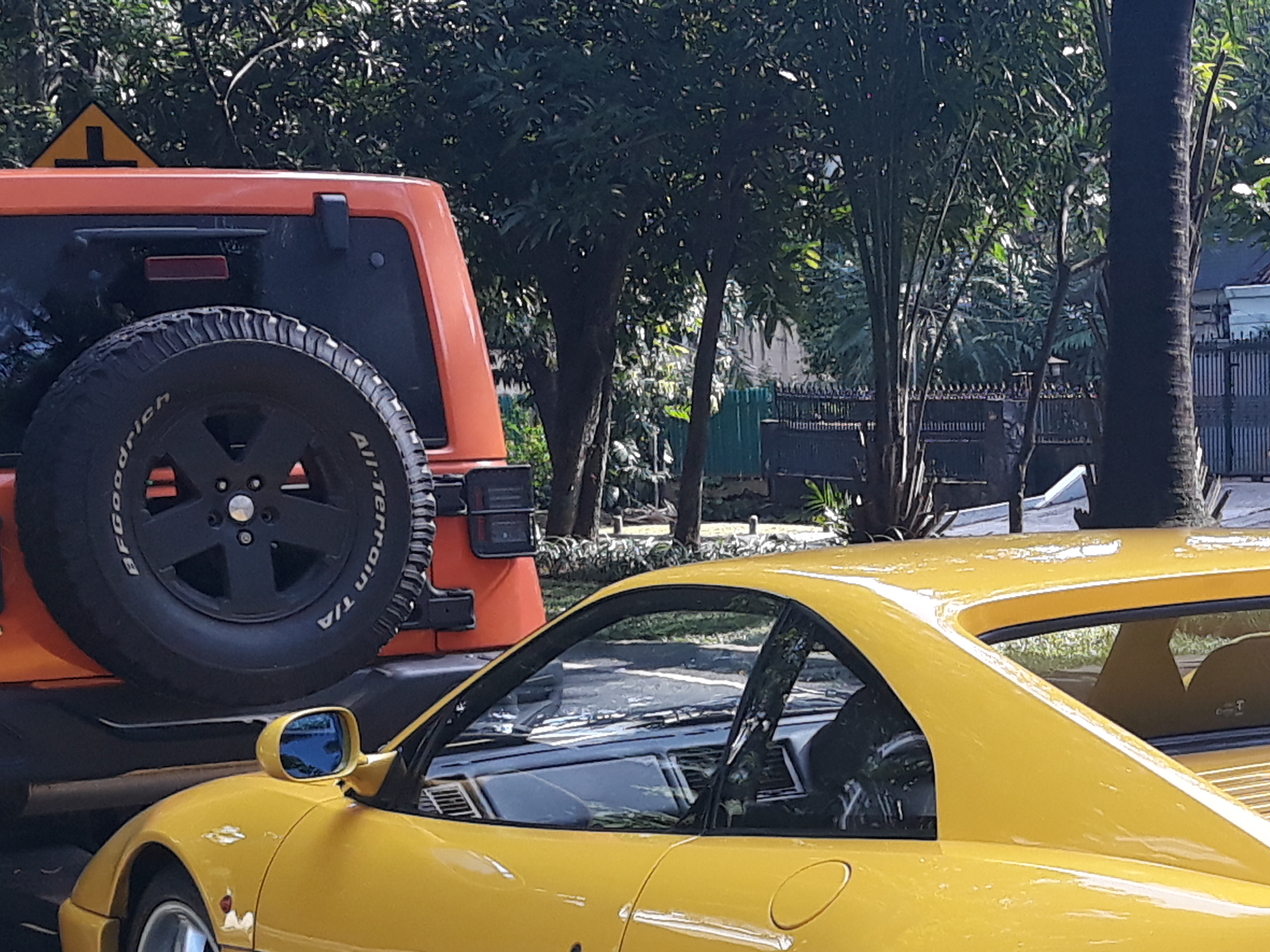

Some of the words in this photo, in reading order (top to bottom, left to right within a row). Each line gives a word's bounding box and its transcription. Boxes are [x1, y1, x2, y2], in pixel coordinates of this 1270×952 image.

[111, 392, 171, 575] BFGoodrich
[350, 431, 386, 591] All-Terrain
[316, 595, 355, 629] T/A
